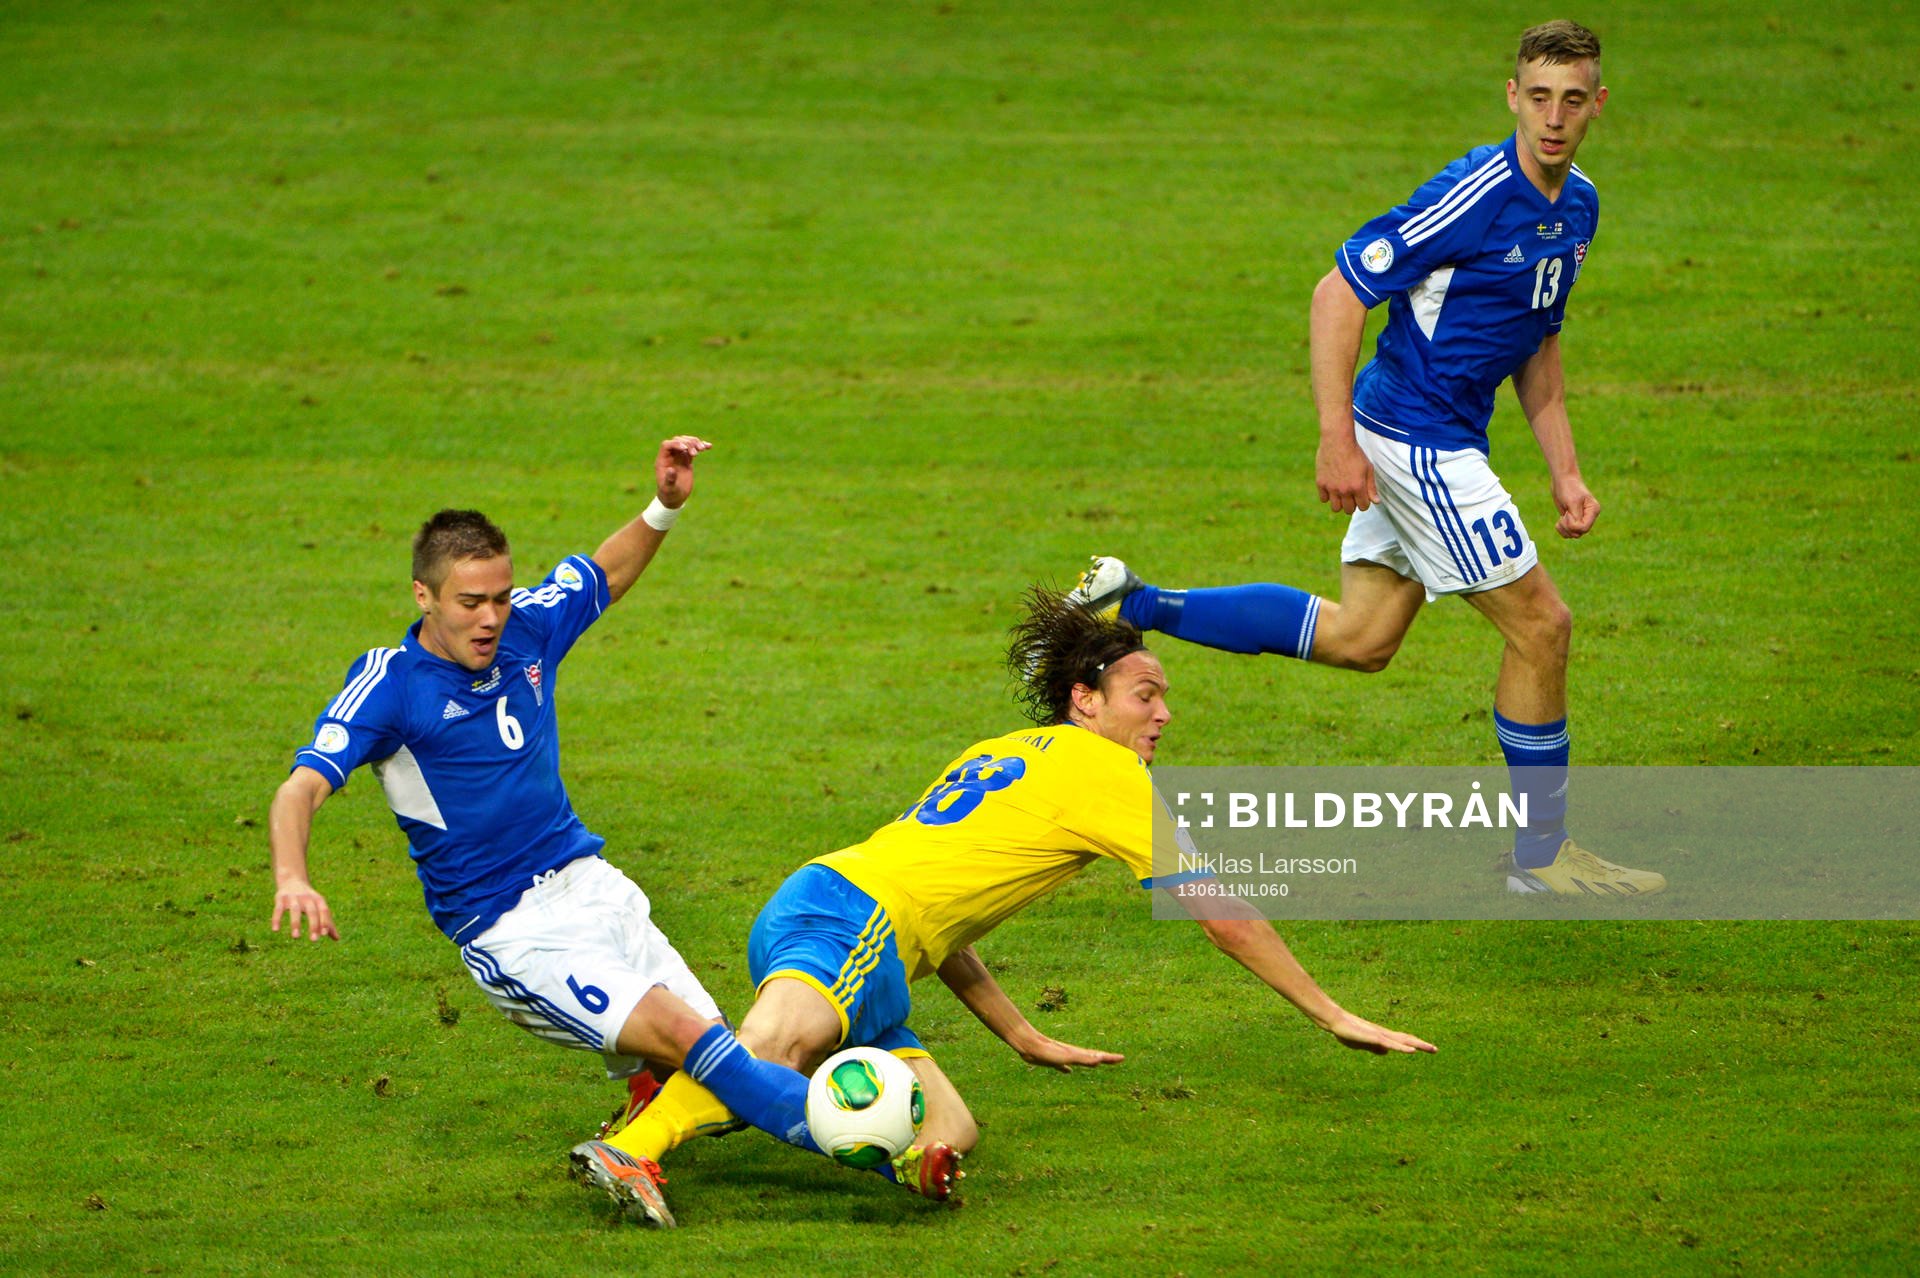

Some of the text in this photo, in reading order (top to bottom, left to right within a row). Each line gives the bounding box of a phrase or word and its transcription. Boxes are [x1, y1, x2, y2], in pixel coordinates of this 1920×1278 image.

[1532, 257, 1563, 310] 13
[1472, 509, 1523, 567] 13
[496, 695, 524, 751] 6
[566, 974, 610, 1014] 6
